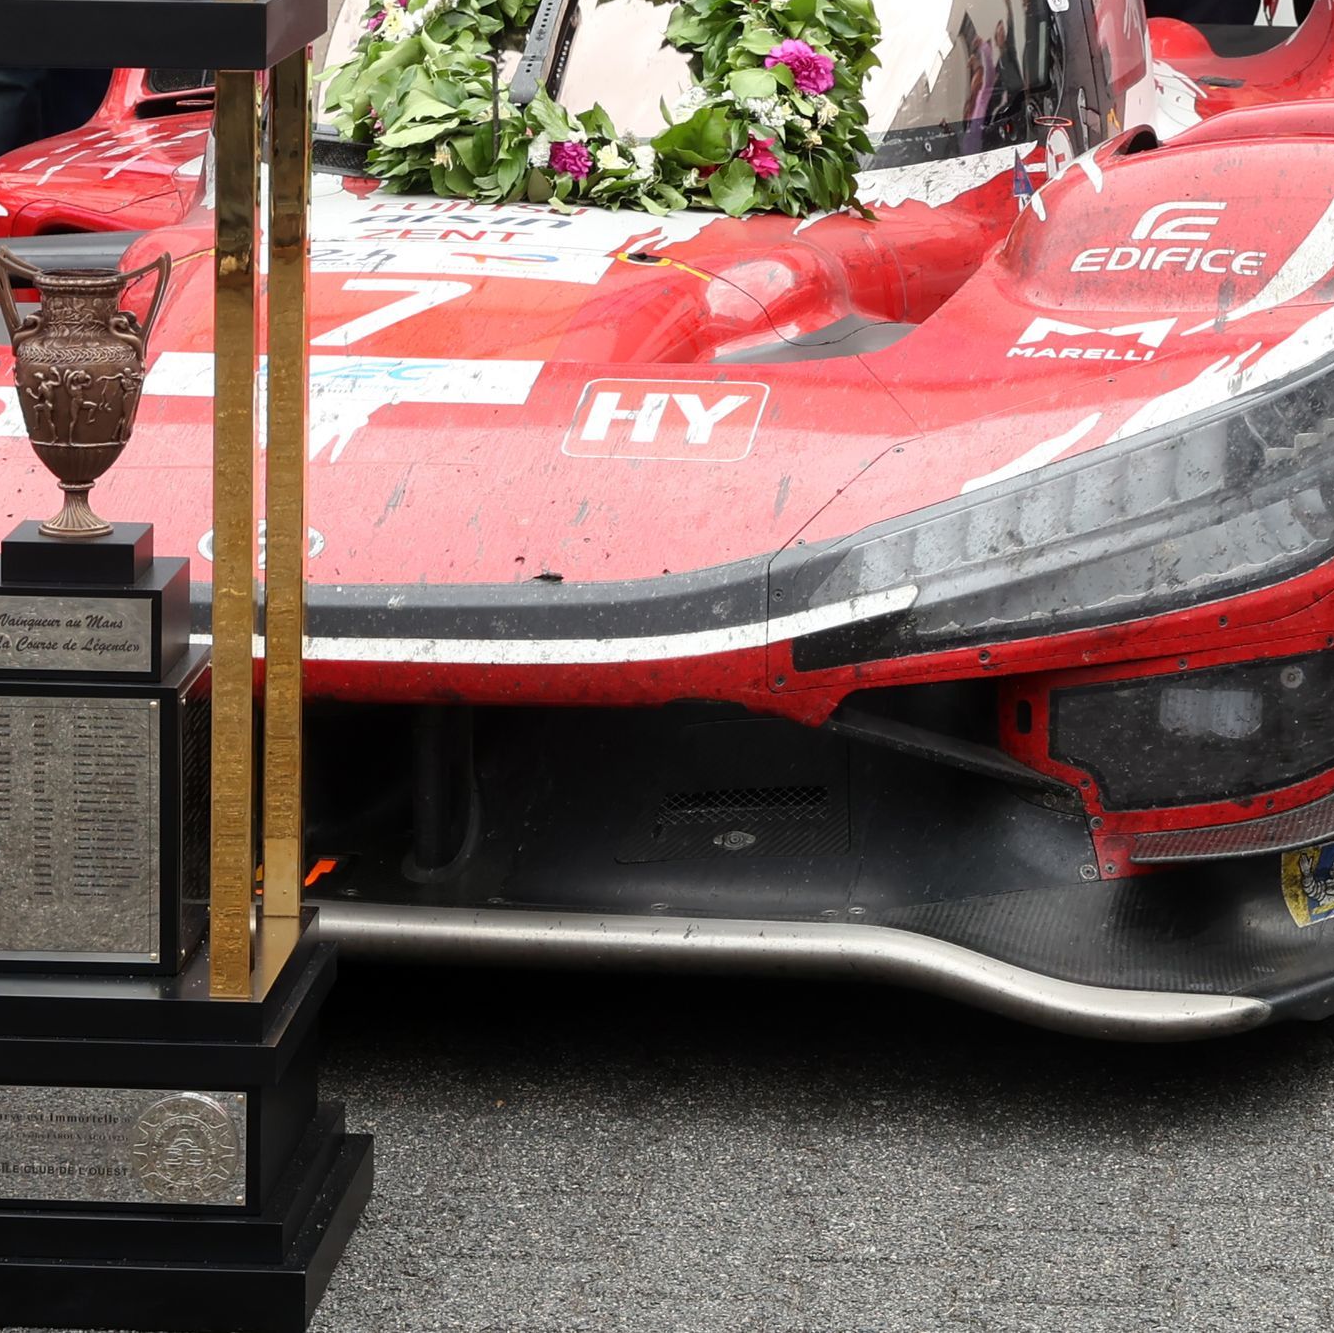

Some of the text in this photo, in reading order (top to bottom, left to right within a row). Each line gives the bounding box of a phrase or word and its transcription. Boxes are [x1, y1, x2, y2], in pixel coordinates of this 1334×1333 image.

[354, 228, 535, 243] ZENT
[1070, 246, 1267, 276] EDIFICE
[309, 278, 473, 347] 7
[1005, 347, 1156, 362] MARELLI
[579, 391, 753, 445] HY
[65, 618, 82, 629] au
[84, 613, 124, 630] Mans
[15, 634, 58, 652] Course
[62, 637, 77, 651] de
[23, 1165, 55, 1175] CLUB
[58, 1166, 75, 1175] DE
